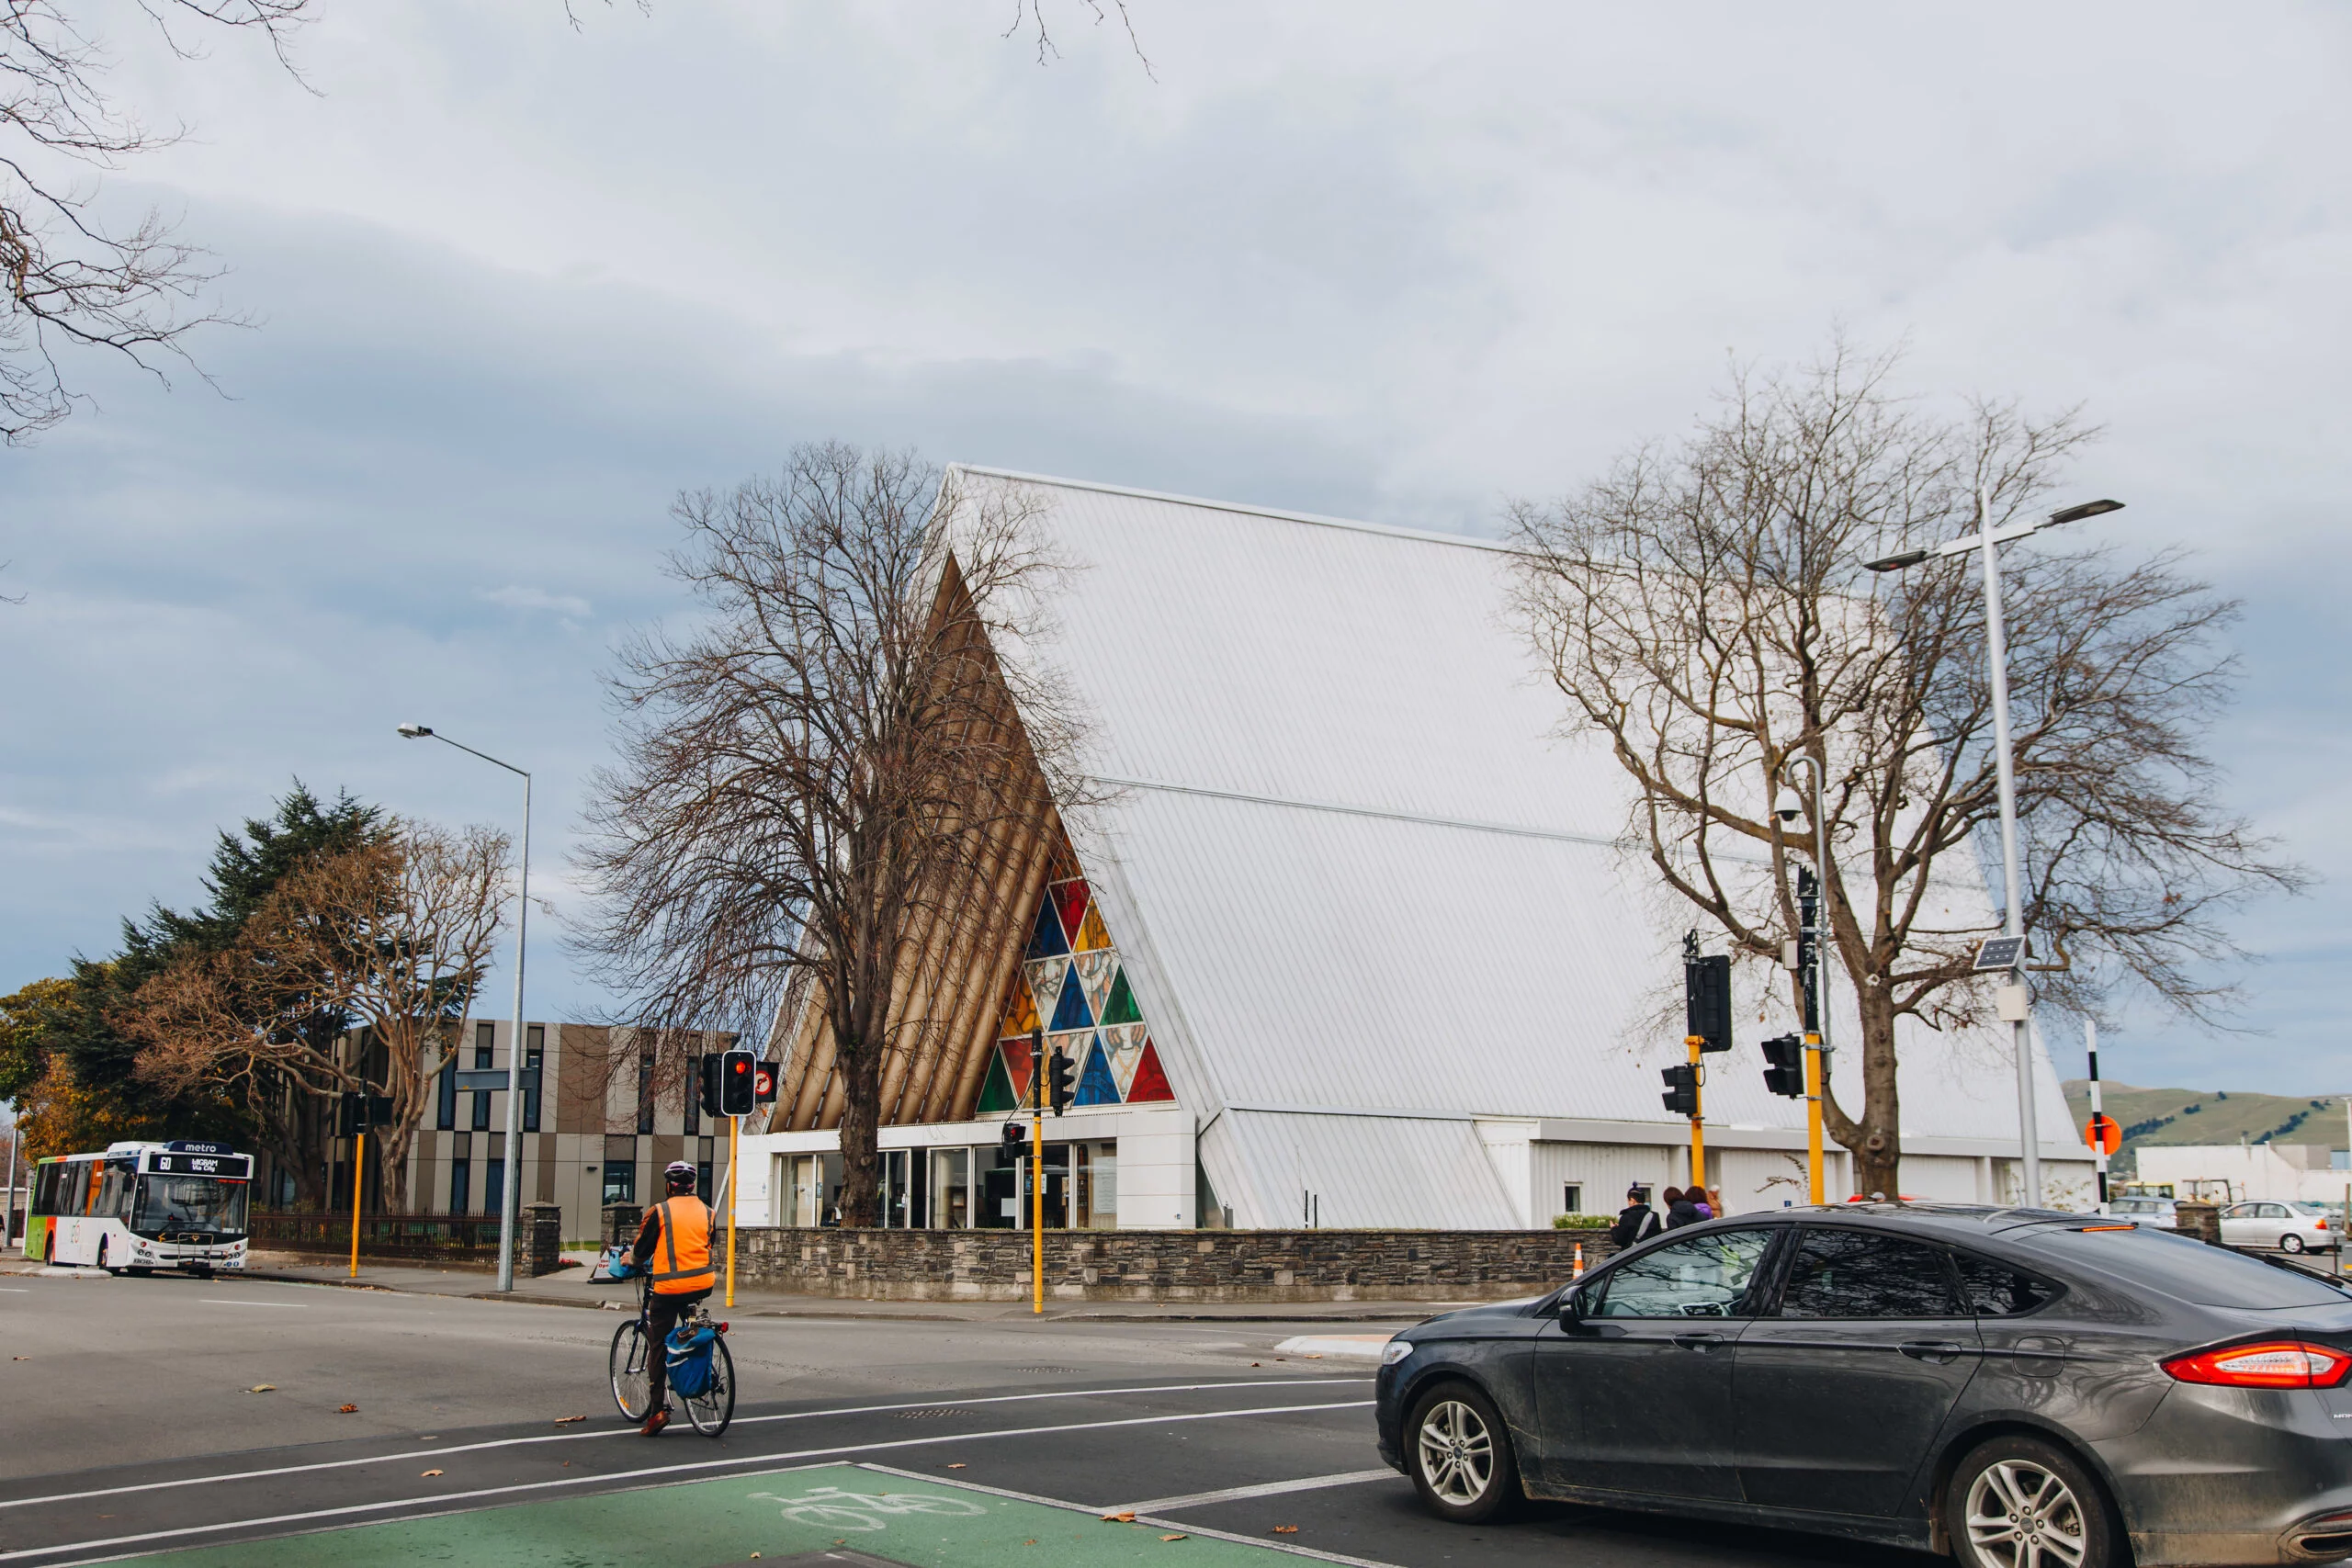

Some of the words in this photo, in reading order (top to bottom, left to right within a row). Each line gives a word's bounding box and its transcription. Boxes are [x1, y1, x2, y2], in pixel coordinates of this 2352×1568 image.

[186, 1144, 216, 1153] metro
[160, 1156, 171, 1169] 60
[191, 1158, 218, 1167] WIGRAM
